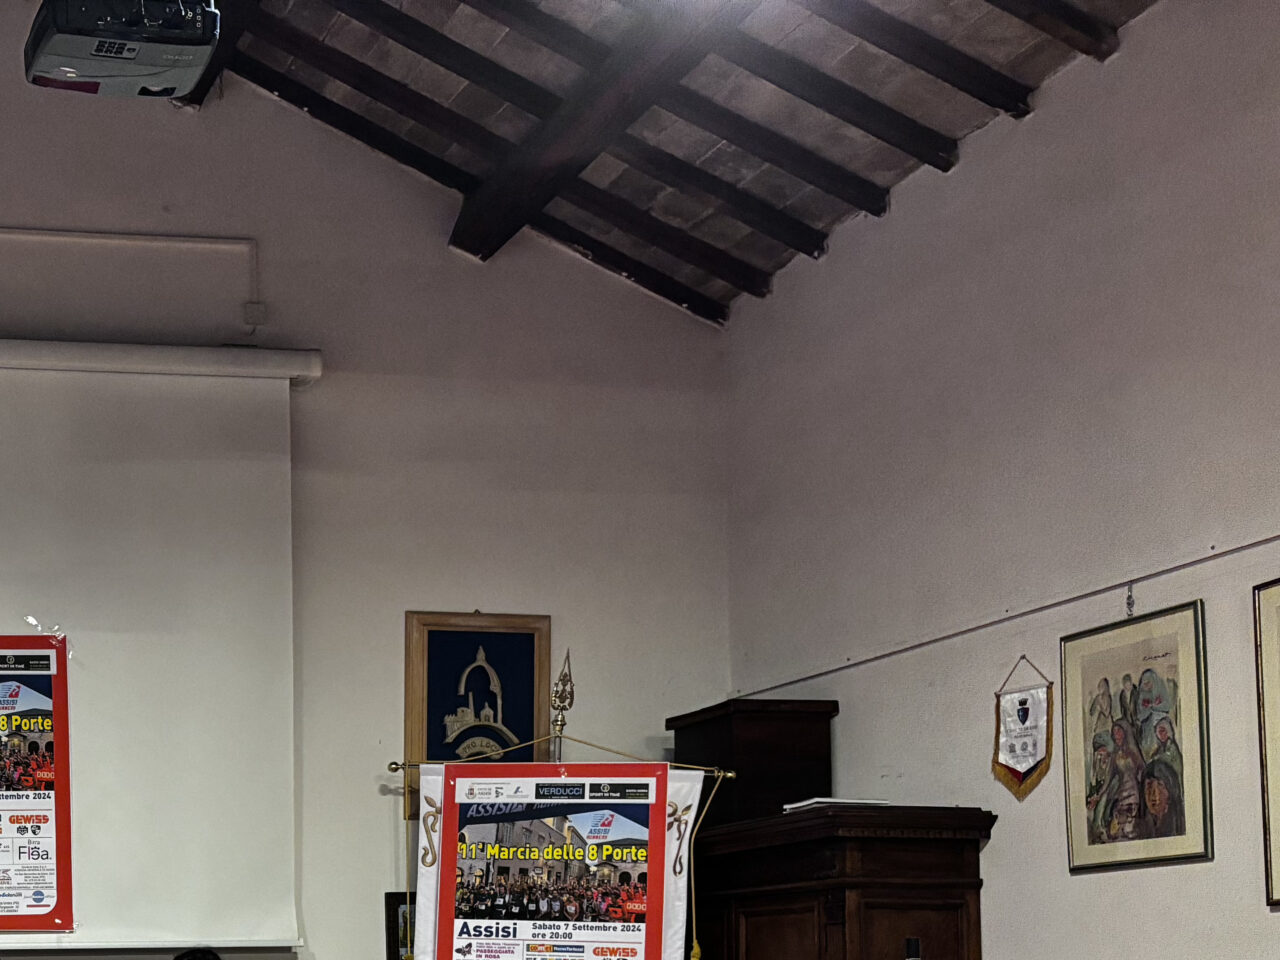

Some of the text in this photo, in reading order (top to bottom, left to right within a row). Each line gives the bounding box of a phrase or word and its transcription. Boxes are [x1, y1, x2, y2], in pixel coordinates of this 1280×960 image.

[0, 716, 7, 731] 8
[12, 716, 52, 730] Porte
[539, 787, 583, 796] VERDUCCI
[487, 844, 538, 860] Marcia
[543, 844, 584, 861] delle
[587, 845, 598, 861] 8
[603, 845, 647, 861] Porte
[458, 922, 517, 938] Assisi
[572, 924, 617, 932] Settembre
[621, 924, 641, 932] 2024
